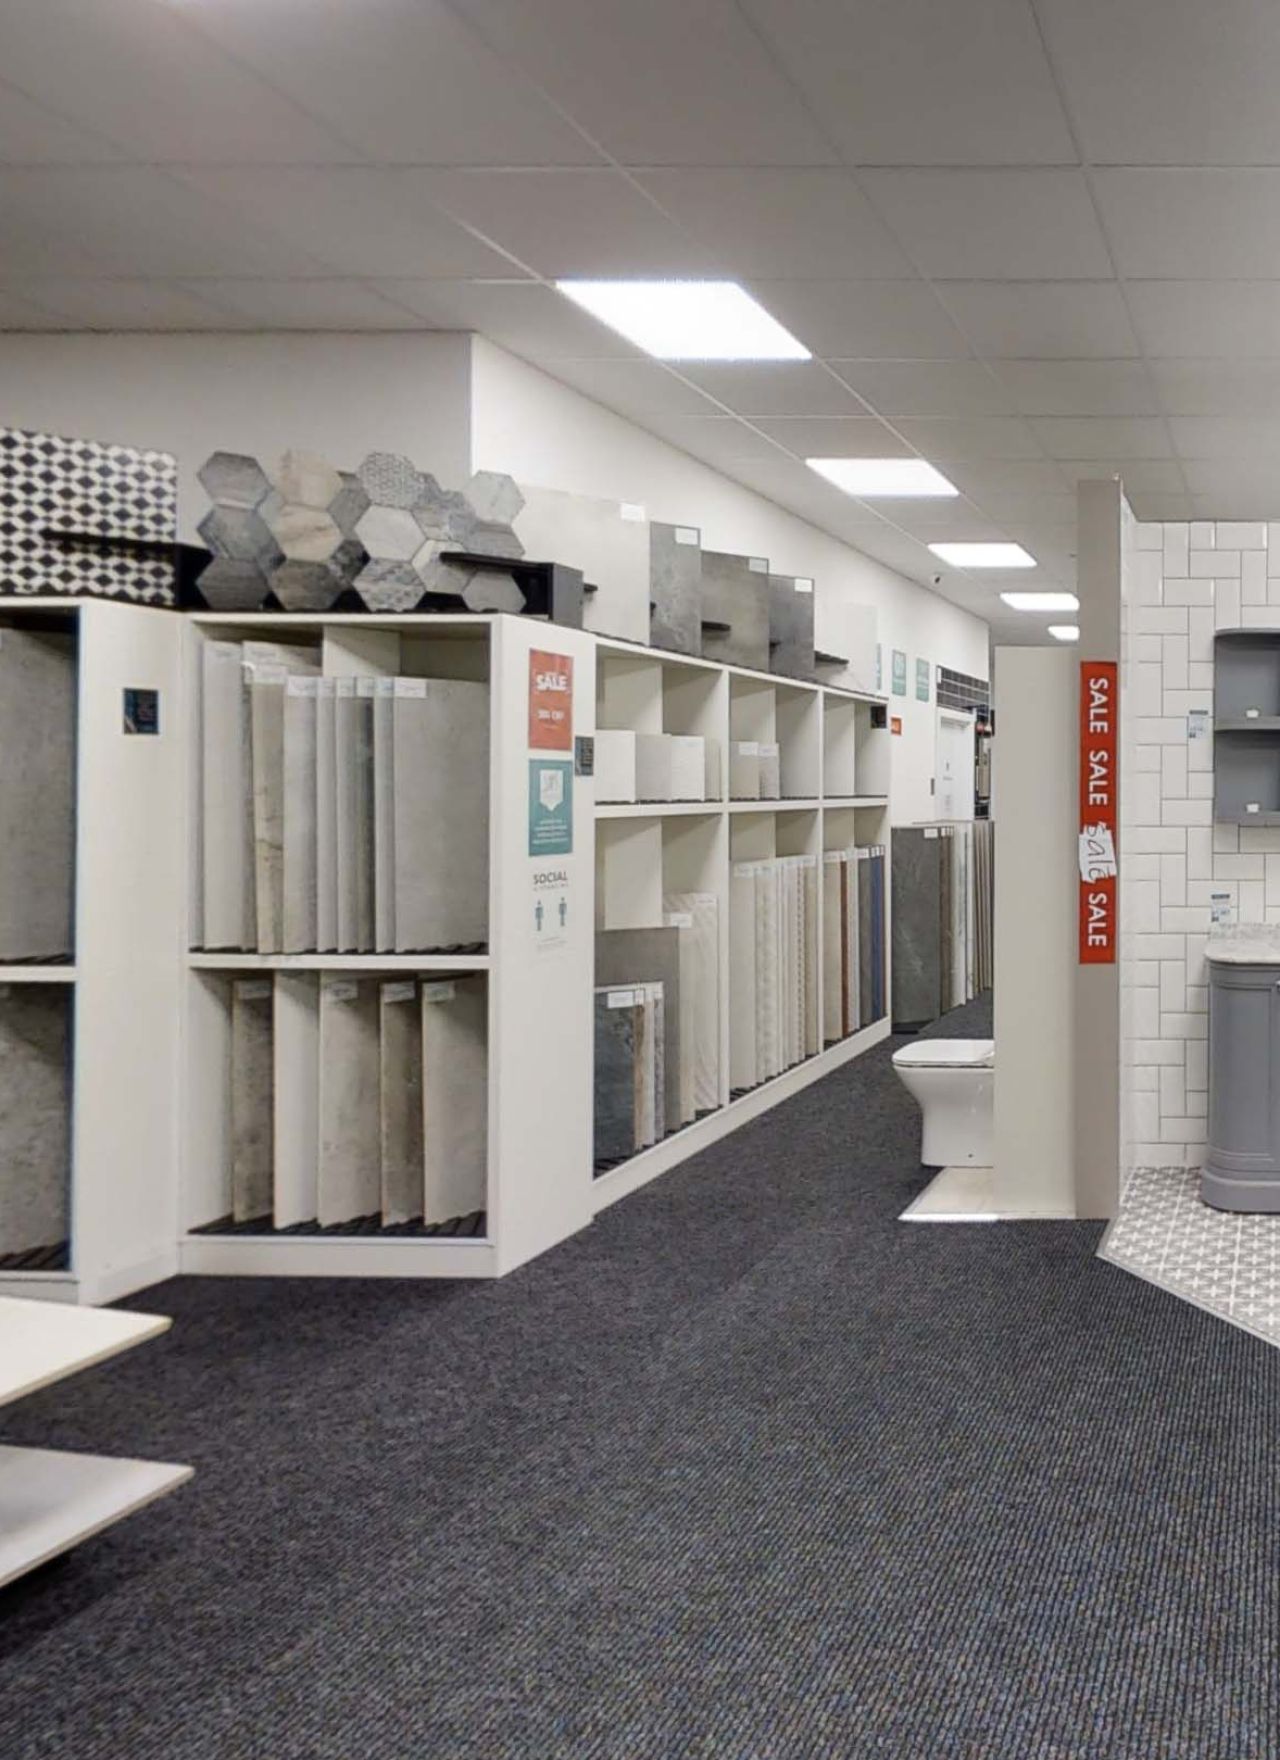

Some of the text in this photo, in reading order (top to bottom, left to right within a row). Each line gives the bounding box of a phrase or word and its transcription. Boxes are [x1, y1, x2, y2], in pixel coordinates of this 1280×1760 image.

[536, 674, 568, 692] SALE
[1088, 677, 1109, 806] SALE SALE
[533, 871, 569, 885] SOCIAL
[1088, 892, 1107, 947] SALE
